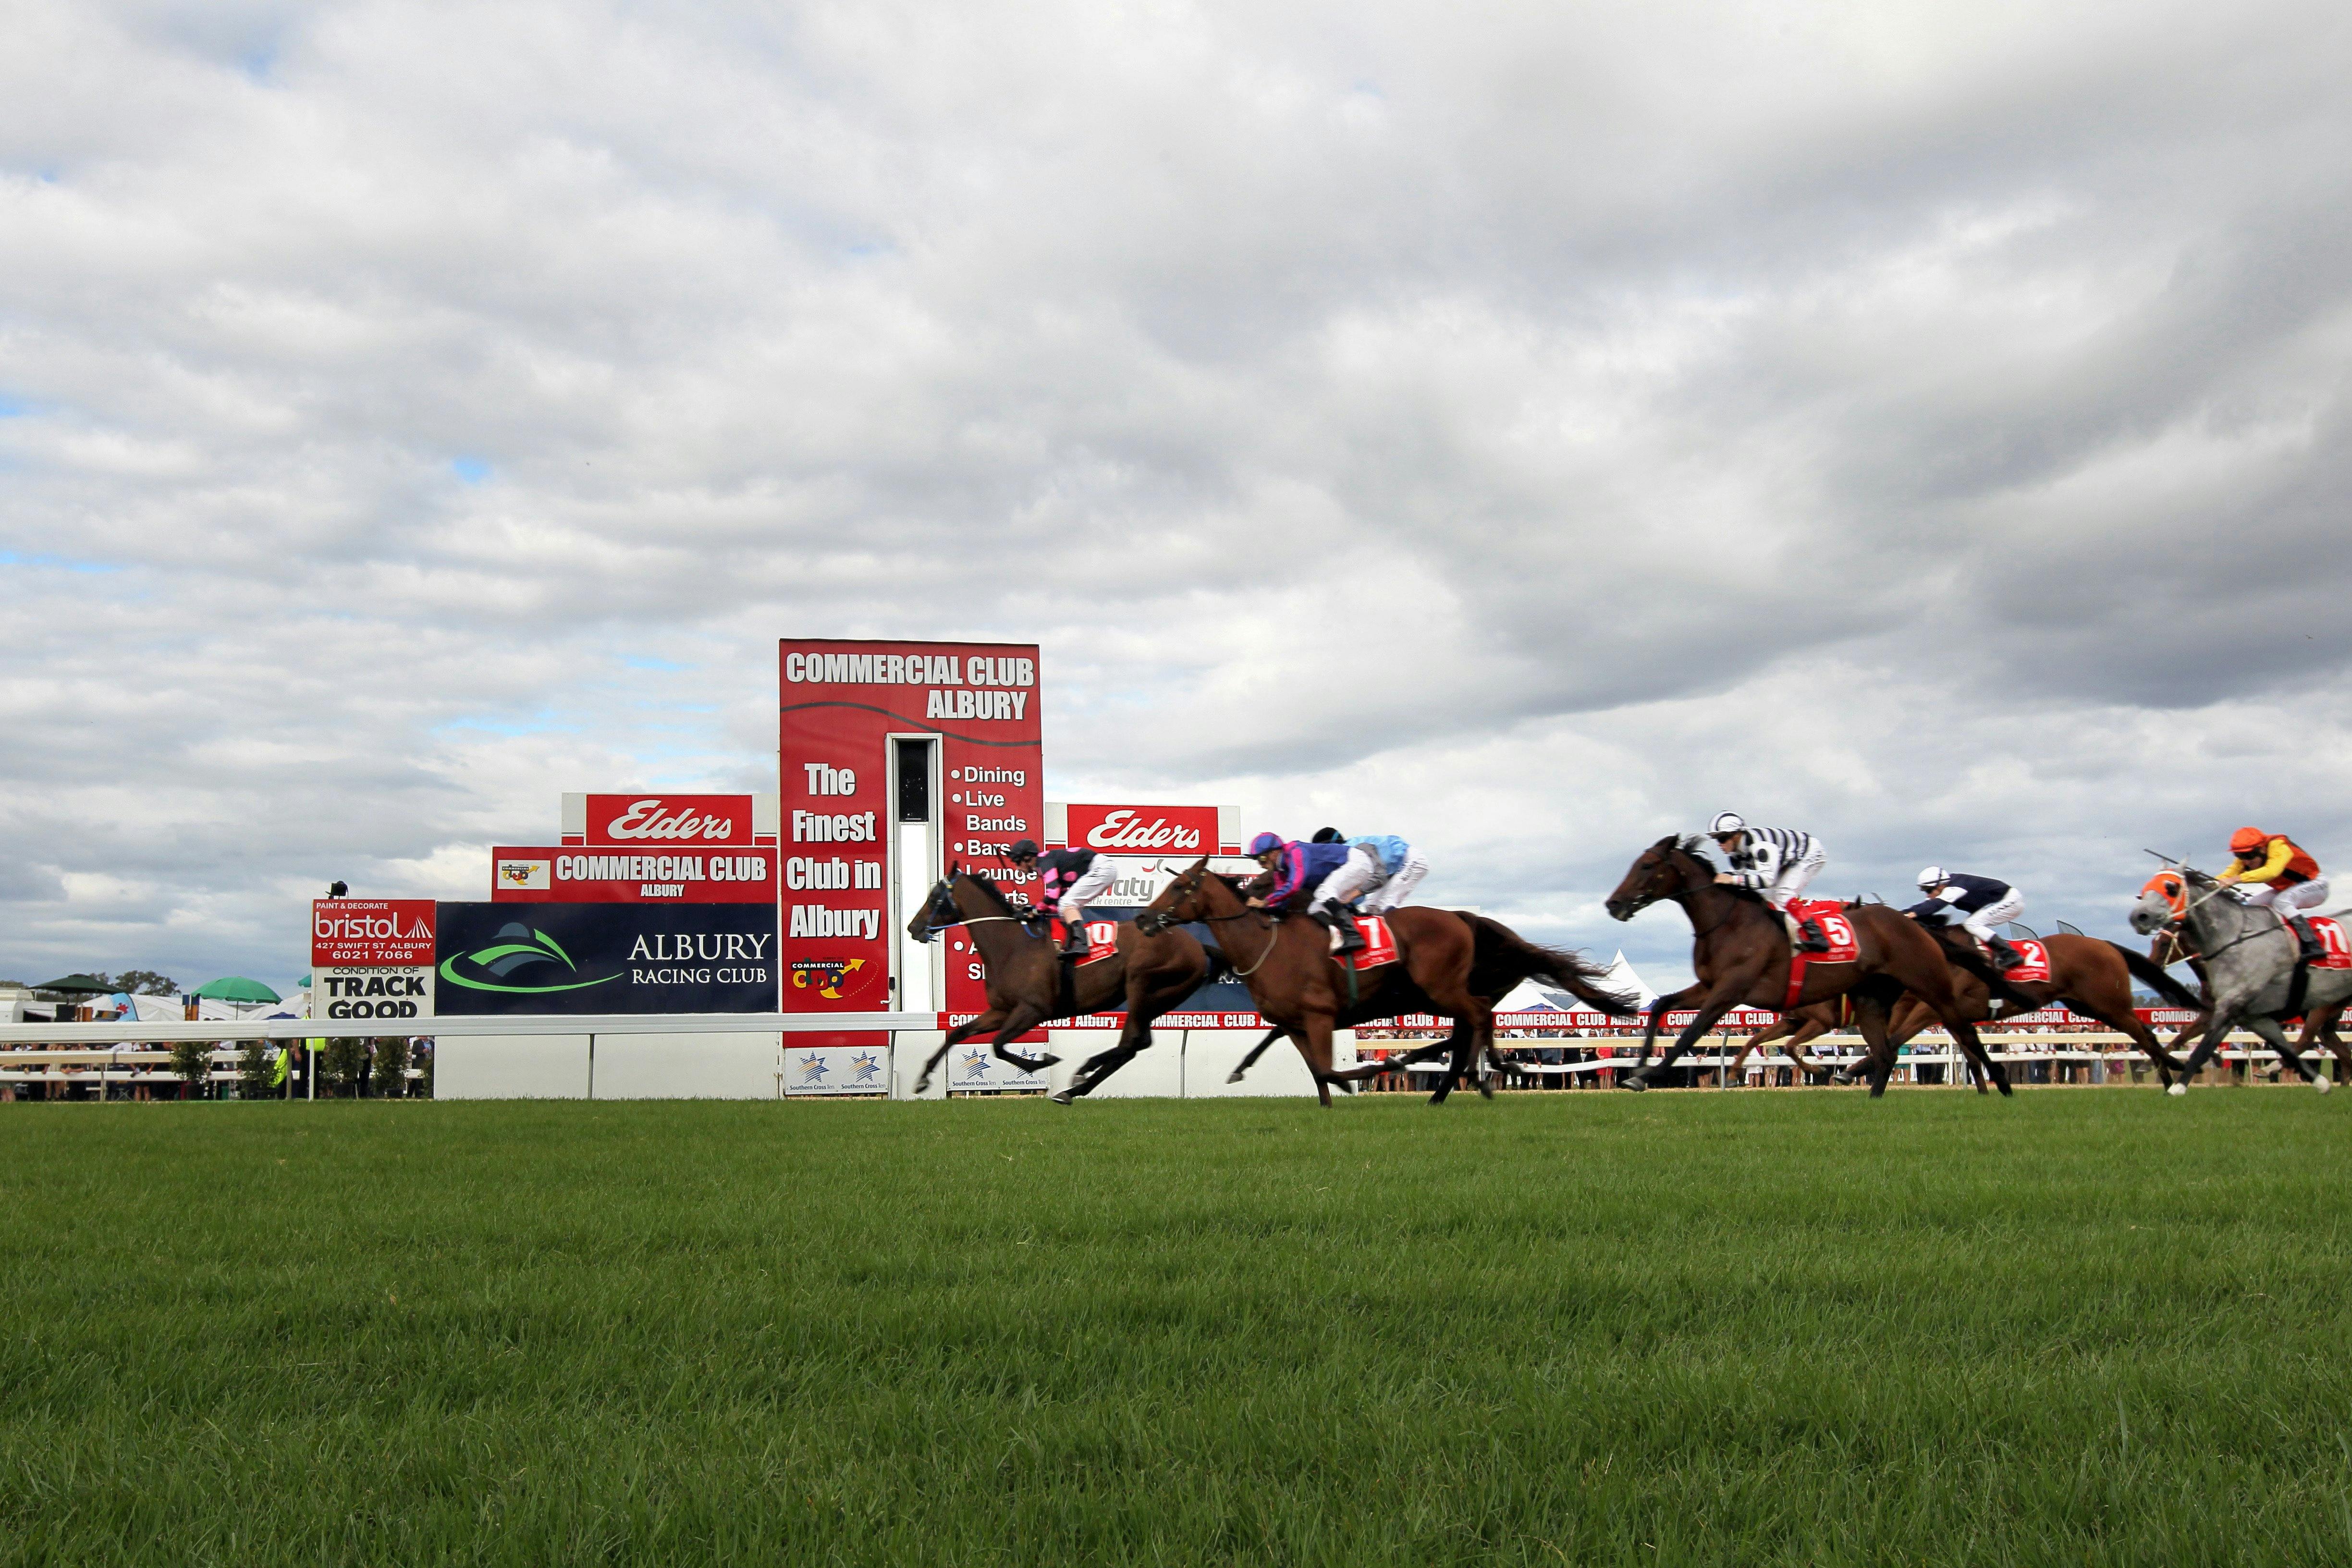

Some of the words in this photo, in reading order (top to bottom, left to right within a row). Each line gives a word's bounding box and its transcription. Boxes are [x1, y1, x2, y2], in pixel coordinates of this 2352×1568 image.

[786, 652, 963, 685] COMMERCIAL
[967, 656, 1034, 686] CLUB
[926, 689, 1028, 720] ALBURY
[804, 763, 856, 796] The
[964, 766, 1025, 786] Dining
[966, 790, 1004, 807] Live
[607, 799, 732, 840] Elders
[793, 809, 876, 842] Finest
[966, 814, 1027, 831] Bands
[1087, 809, 1200, 849] Elders
[967, 839, 1011, 856] Bars
[556, 855, 706, 881] COMMERCIAL
[710, 856, 766, 881] CLUB
[786, 857, 849, 890] Club
[854, 859, 881, 889] in
[640, 883, 685, 897] ALBURY
[315, 911, 403, 939] bristol
[789, 904, 880, 940] Albury
[1821, 917, 1852, 945] 5
[1357, 918, 1382, 948] 1
[2315, 922, 2349, 954] 11
[332, 951, 369, 959] 6021
[376, 951, 413, 959] 7066
[626, 933, 772, 960] ALBURY
[2022, 942, 2046, 967] 2
[323, 976, 427, 997] TRACK
[632, 968, 711, 984] RACING
[716, 968, 767, 983] CLUB
[328, 1000, 418, 1019] GOOD
[1667, 1013, 1742, 1026] COMCIAL
[1745, 1013, 1775, 1025] CLUB
[1995, 1011, 2065, 1023] MMERCIAL
[2151, 1010, 2200, 1023] COMMER
[1075, 1015, 1118, 1029] Albury
[1150, 1014, 1220, 1028] MMERCIAL
[1224, 1014, 1256, 1027] CLUB
[1403, 1014, 1434, 1027] CLUB
[1495, 1014, 1573, 1027] COMMERCIAL
[1576, 1014, 1606, 1026] CLUB
